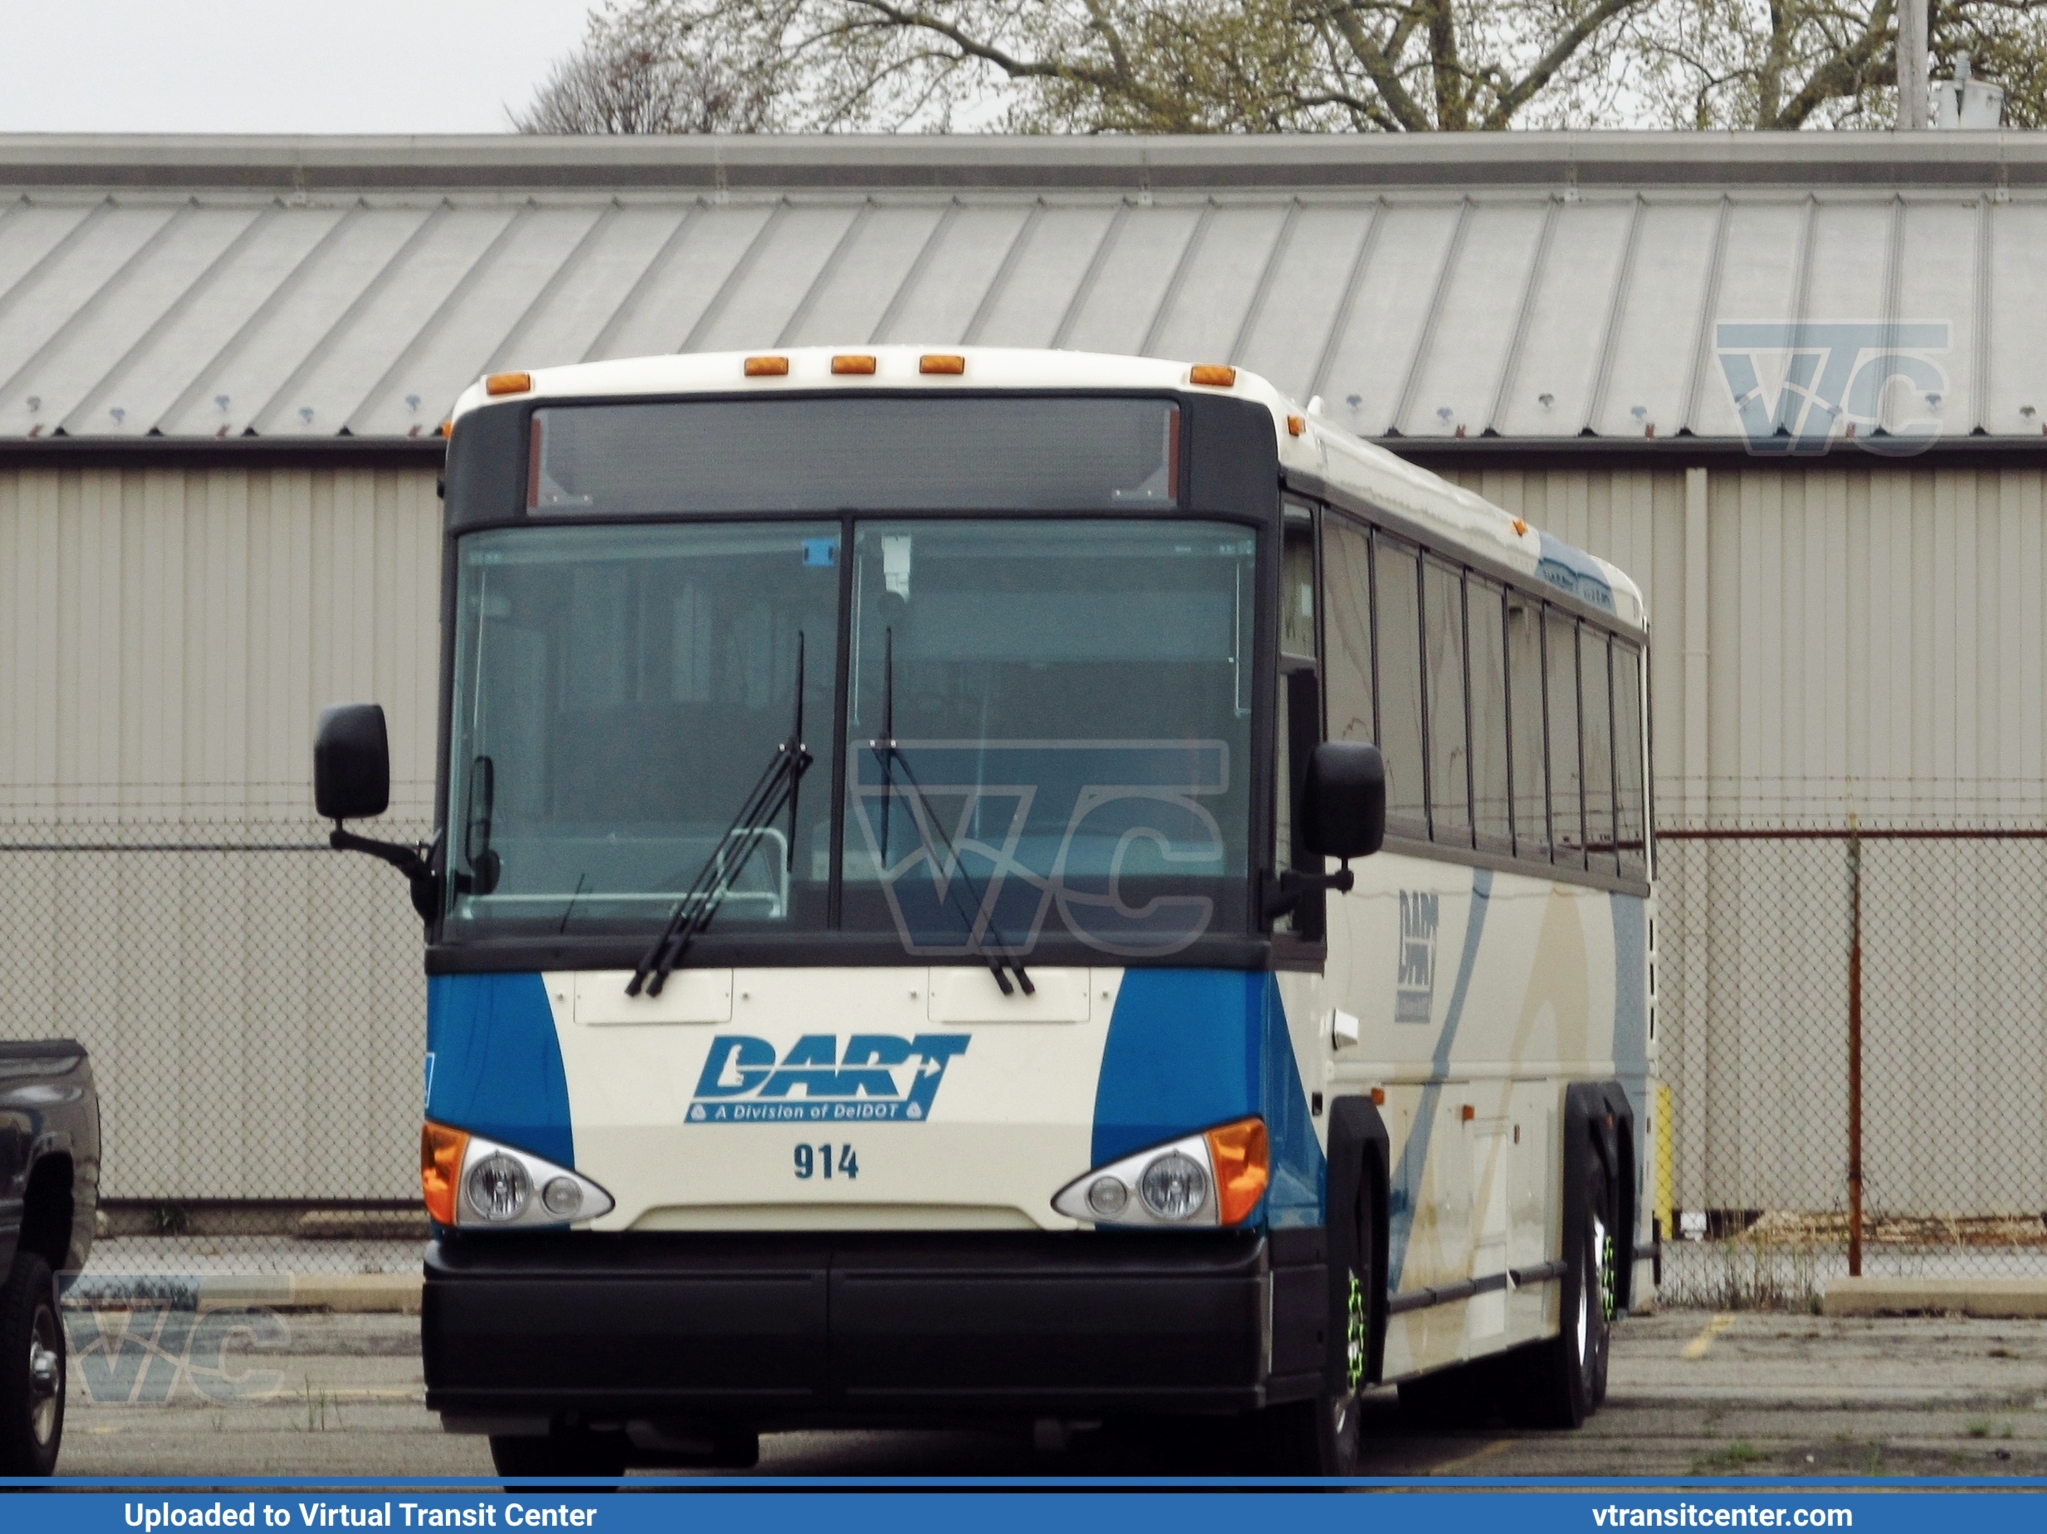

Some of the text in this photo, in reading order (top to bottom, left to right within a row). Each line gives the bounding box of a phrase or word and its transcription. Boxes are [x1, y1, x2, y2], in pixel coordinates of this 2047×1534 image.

[693, 1033, 972, 1099] DART
[714, 1102, 900, 1119] A Division of DelDOT
[793, 1143, 859, 1180] 914
